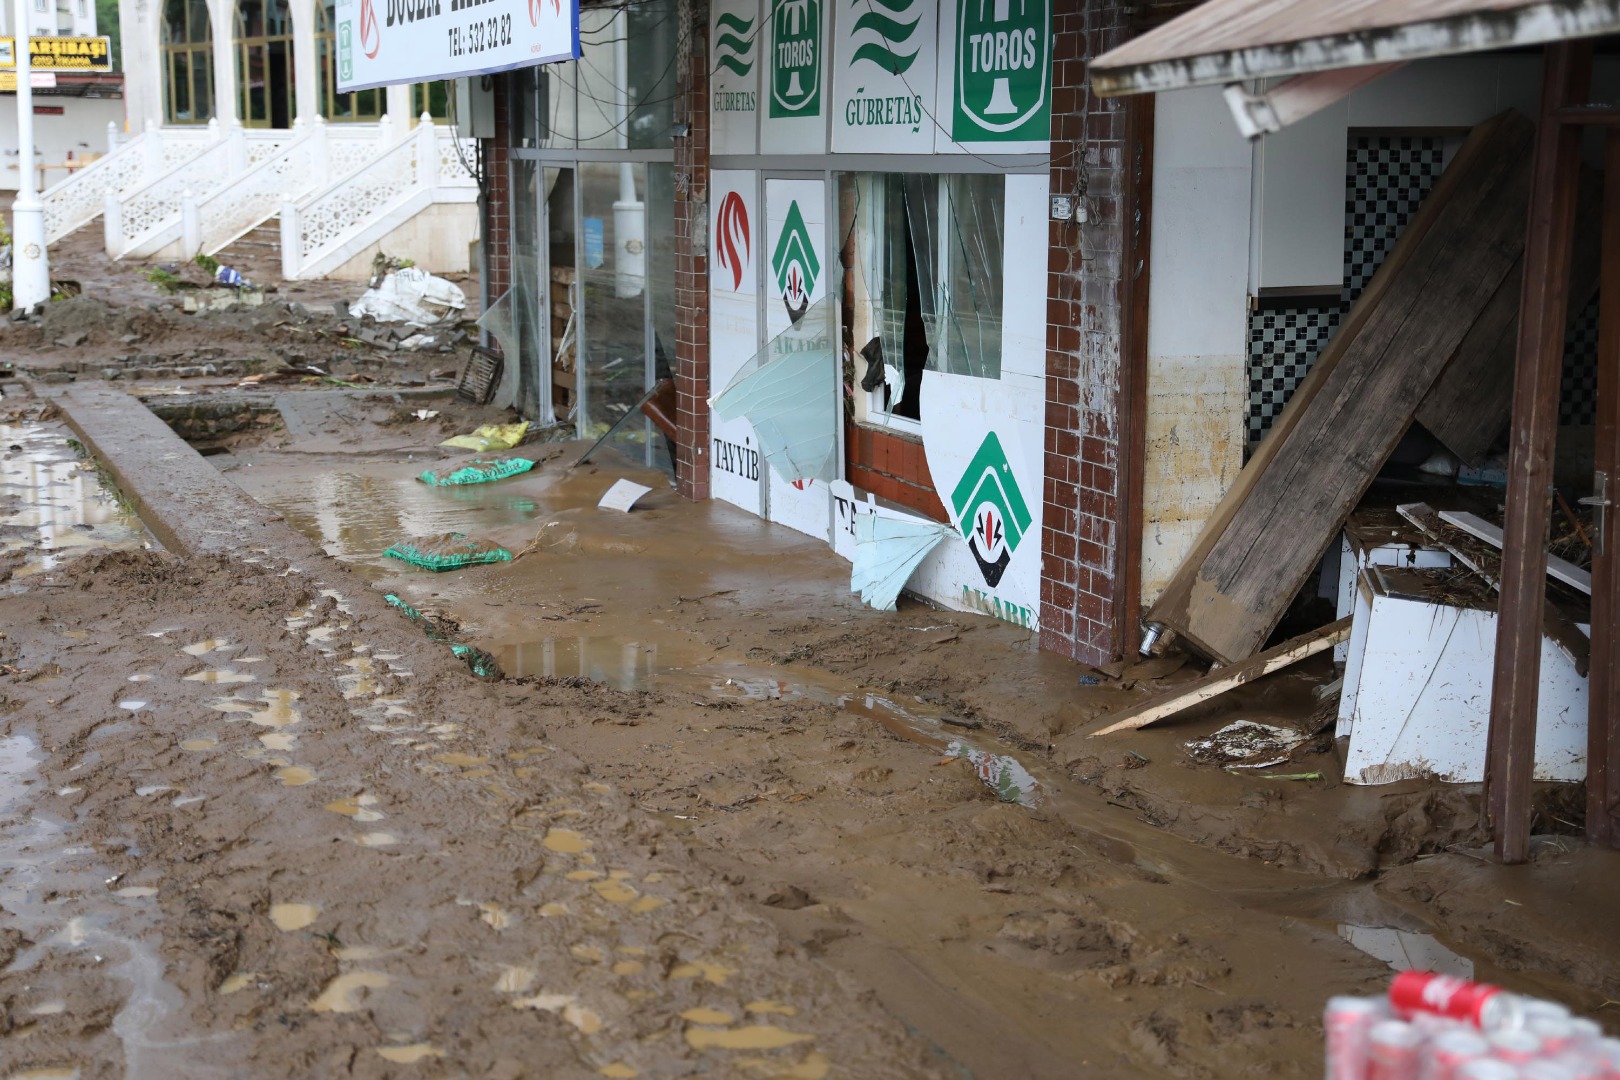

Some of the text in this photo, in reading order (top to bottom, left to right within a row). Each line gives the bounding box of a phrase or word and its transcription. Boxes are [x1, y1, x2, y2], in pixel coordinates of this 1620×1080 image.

[448, 12, 512, 57] TEL: 532 32 82
[778, 38, 814, 69] TOROS
[969, 27, 1037, 73] TOROS
[713, 436, 759, 482] TAYYİB
